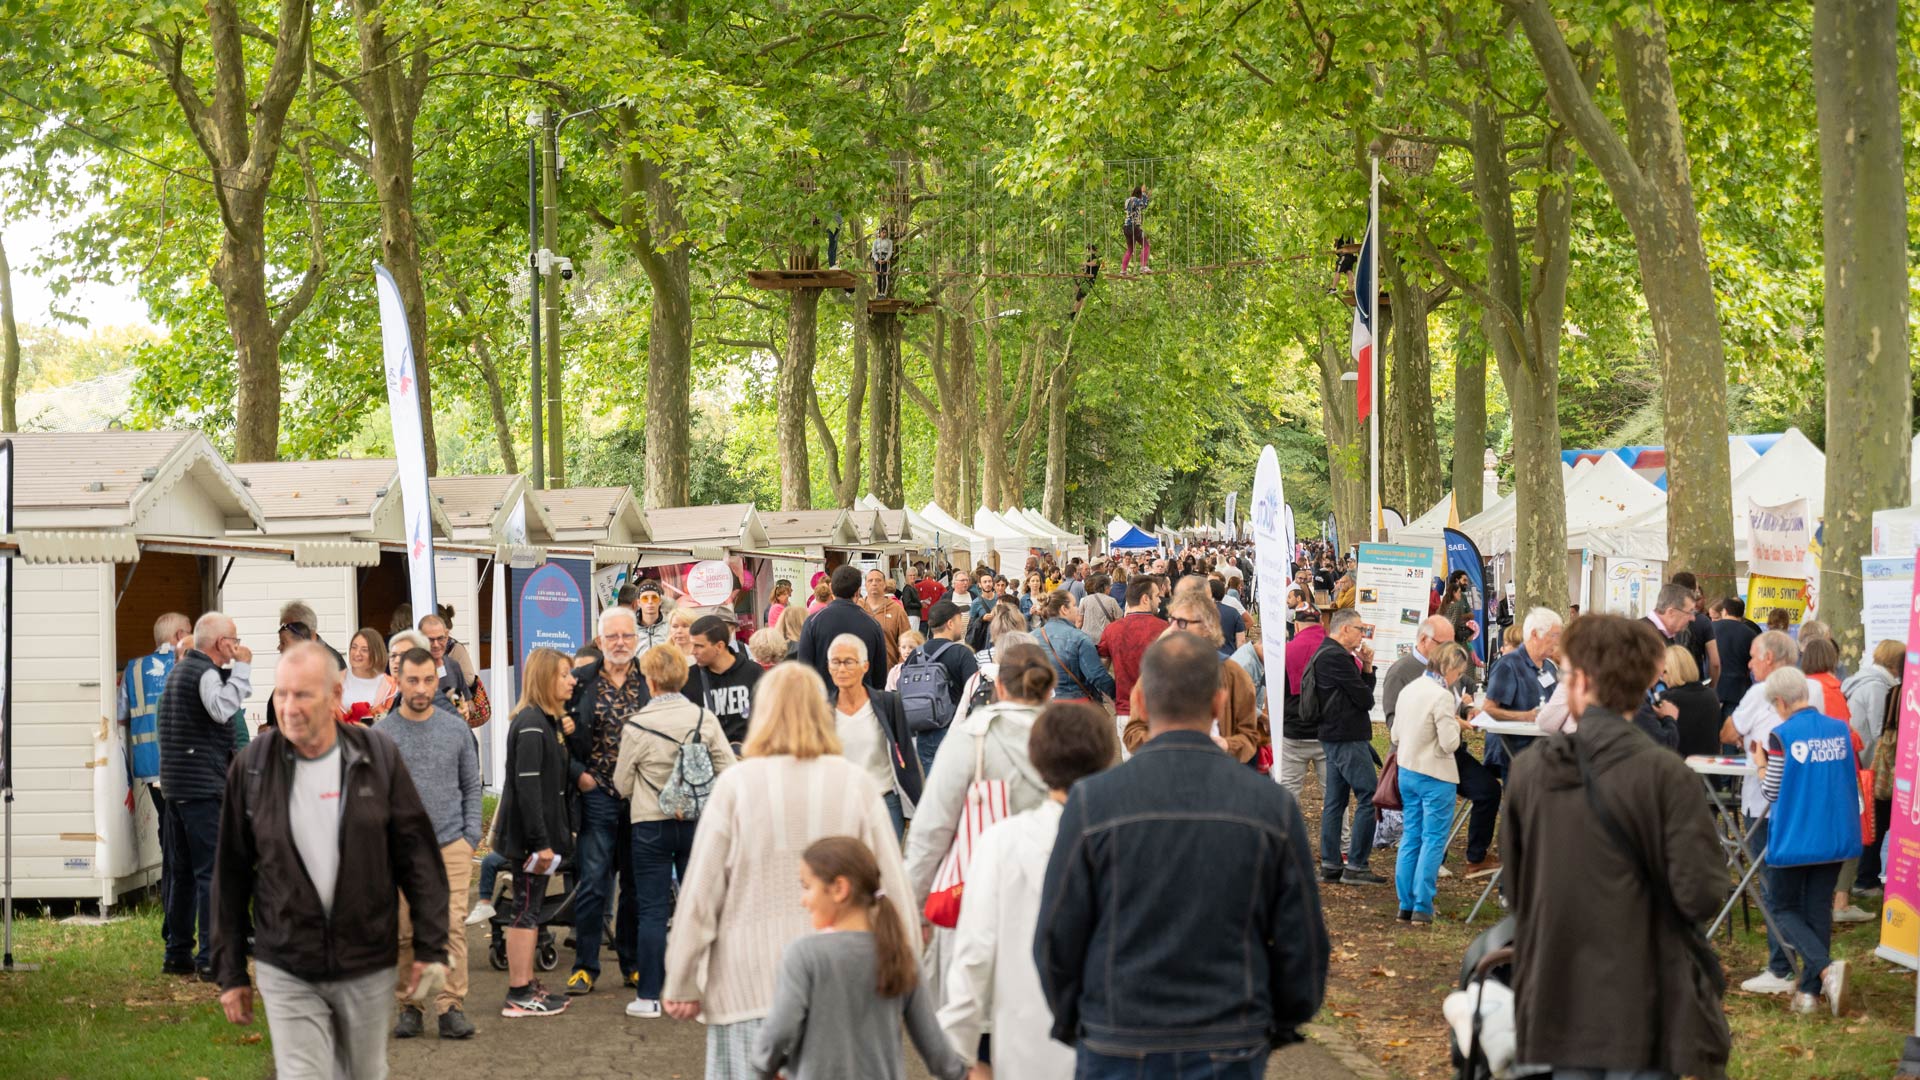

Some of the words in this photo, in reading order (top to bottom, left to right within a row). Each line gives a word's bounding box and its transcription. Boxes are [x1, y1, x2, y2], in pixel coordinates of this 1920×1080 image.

[1447, 543, 1468, 552] SAEL
[1757, 586, 1776, 599] PIANO
[1780, 587, 1803, 601] SYNTH
[536, 629, 571, 640] Ensemble,
[531, 639, 570, 650] participons
[1807, 736, 1846, 751] FRANCE
